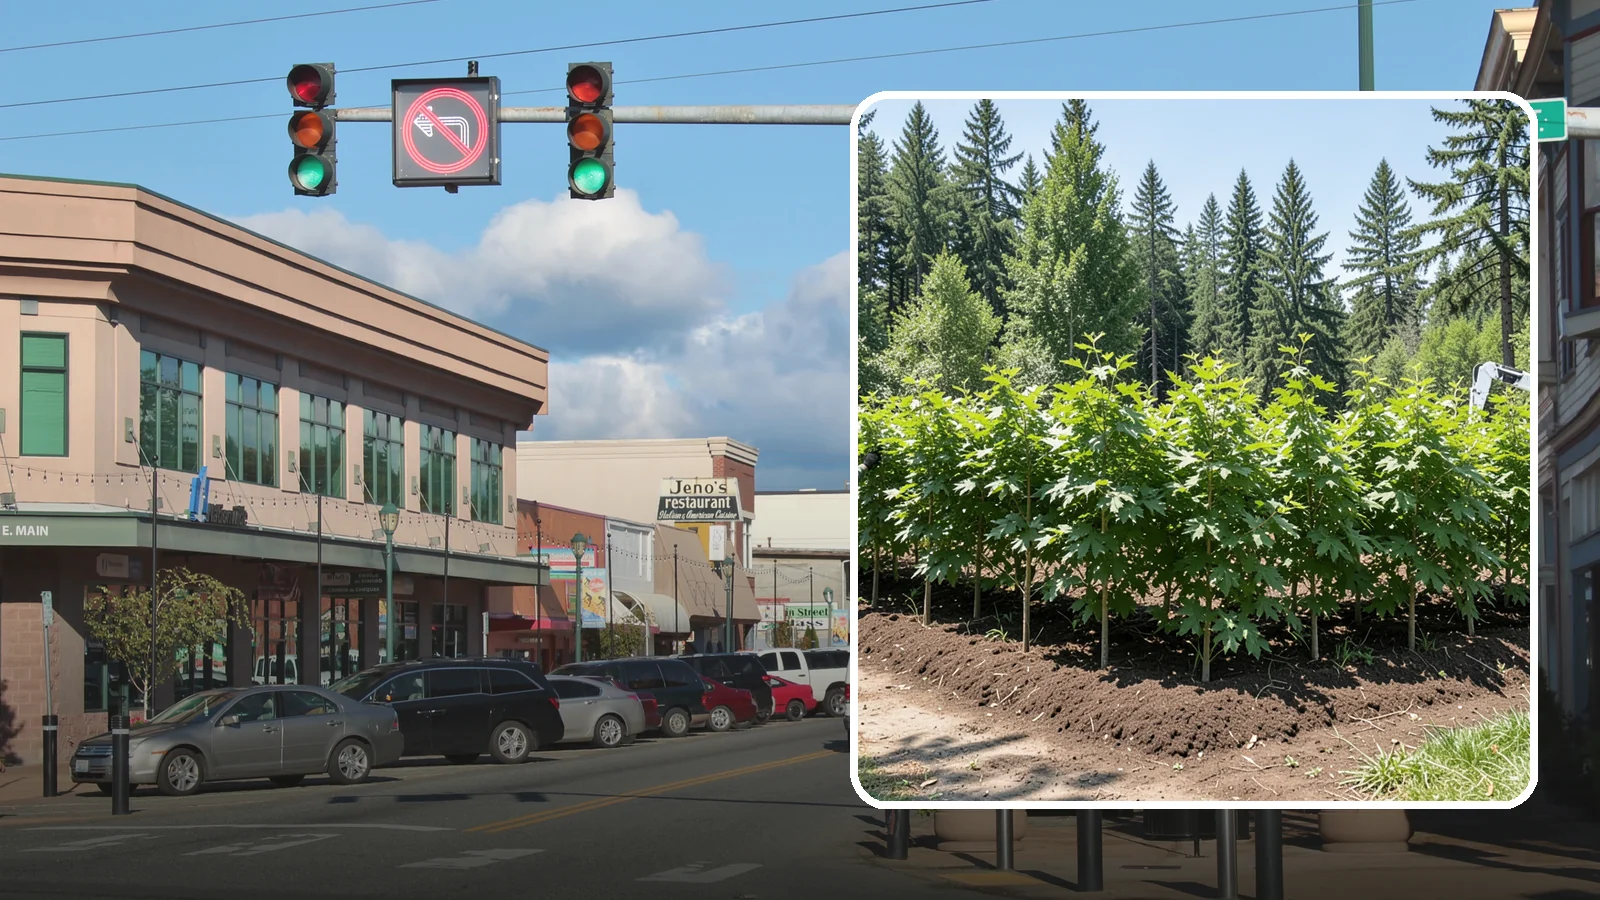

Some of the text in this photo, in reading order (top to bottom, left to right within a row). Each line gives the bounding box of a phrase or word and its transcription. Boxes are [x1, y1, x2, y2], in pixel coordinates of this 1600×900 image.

[670, 480, 727, 494] Jeno's
[665, 496, 731, 509] restaurant
[658, 509, 682, 519] Italian
[686, 510, 714, 519] American
[715, 509, 737, 519] Cuisine
[2, 525, 49, 536] E. MAIN
[797, 607, 829, 617] Street
[790, 619, 824, 627] lass
